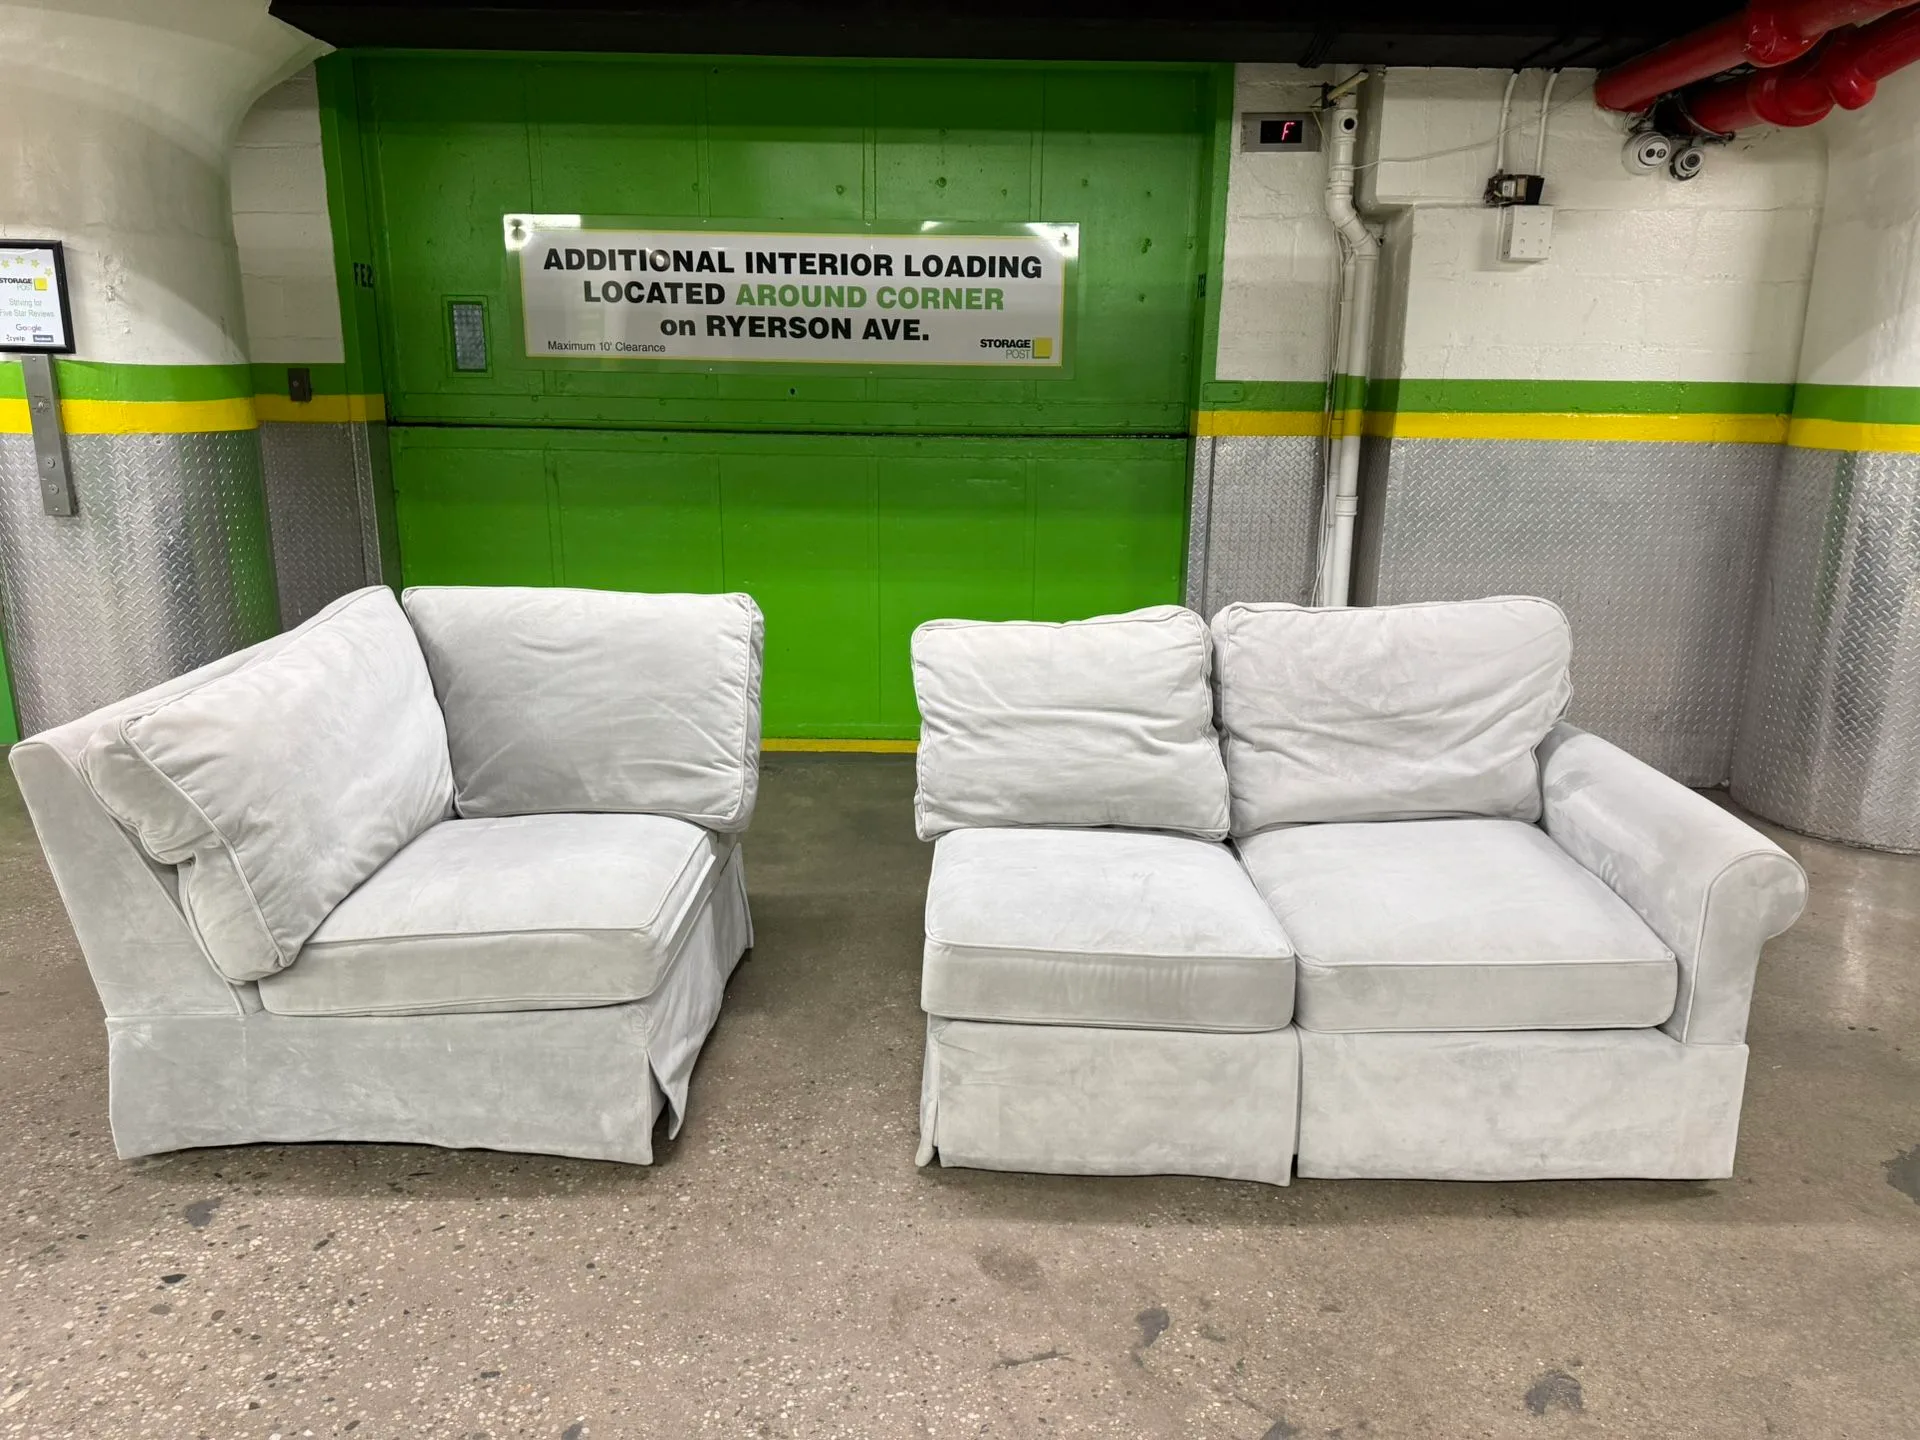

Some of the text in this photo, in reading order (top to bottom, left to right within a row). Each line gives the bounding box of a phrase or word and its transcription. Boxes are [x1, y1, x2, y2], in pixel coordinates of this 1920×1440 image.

[1281, 121, 1296, 141] F
[543, 247, 1042, 278] ADDITIONAL INTERIOR LOADING
[583, 280, 1004, 311] LOCATED AROUND CORNER
[9, 298, 33, 307] Striving
[15, 323, 42, 333] Google
[660, 315, 930, 341] on RYERSON AVE.
[548, 340, 666, 352] Maximum 10' Clearance
[980, 338, 1031, 349] STORAGE
[1005, 349, 1030, 359] POST
